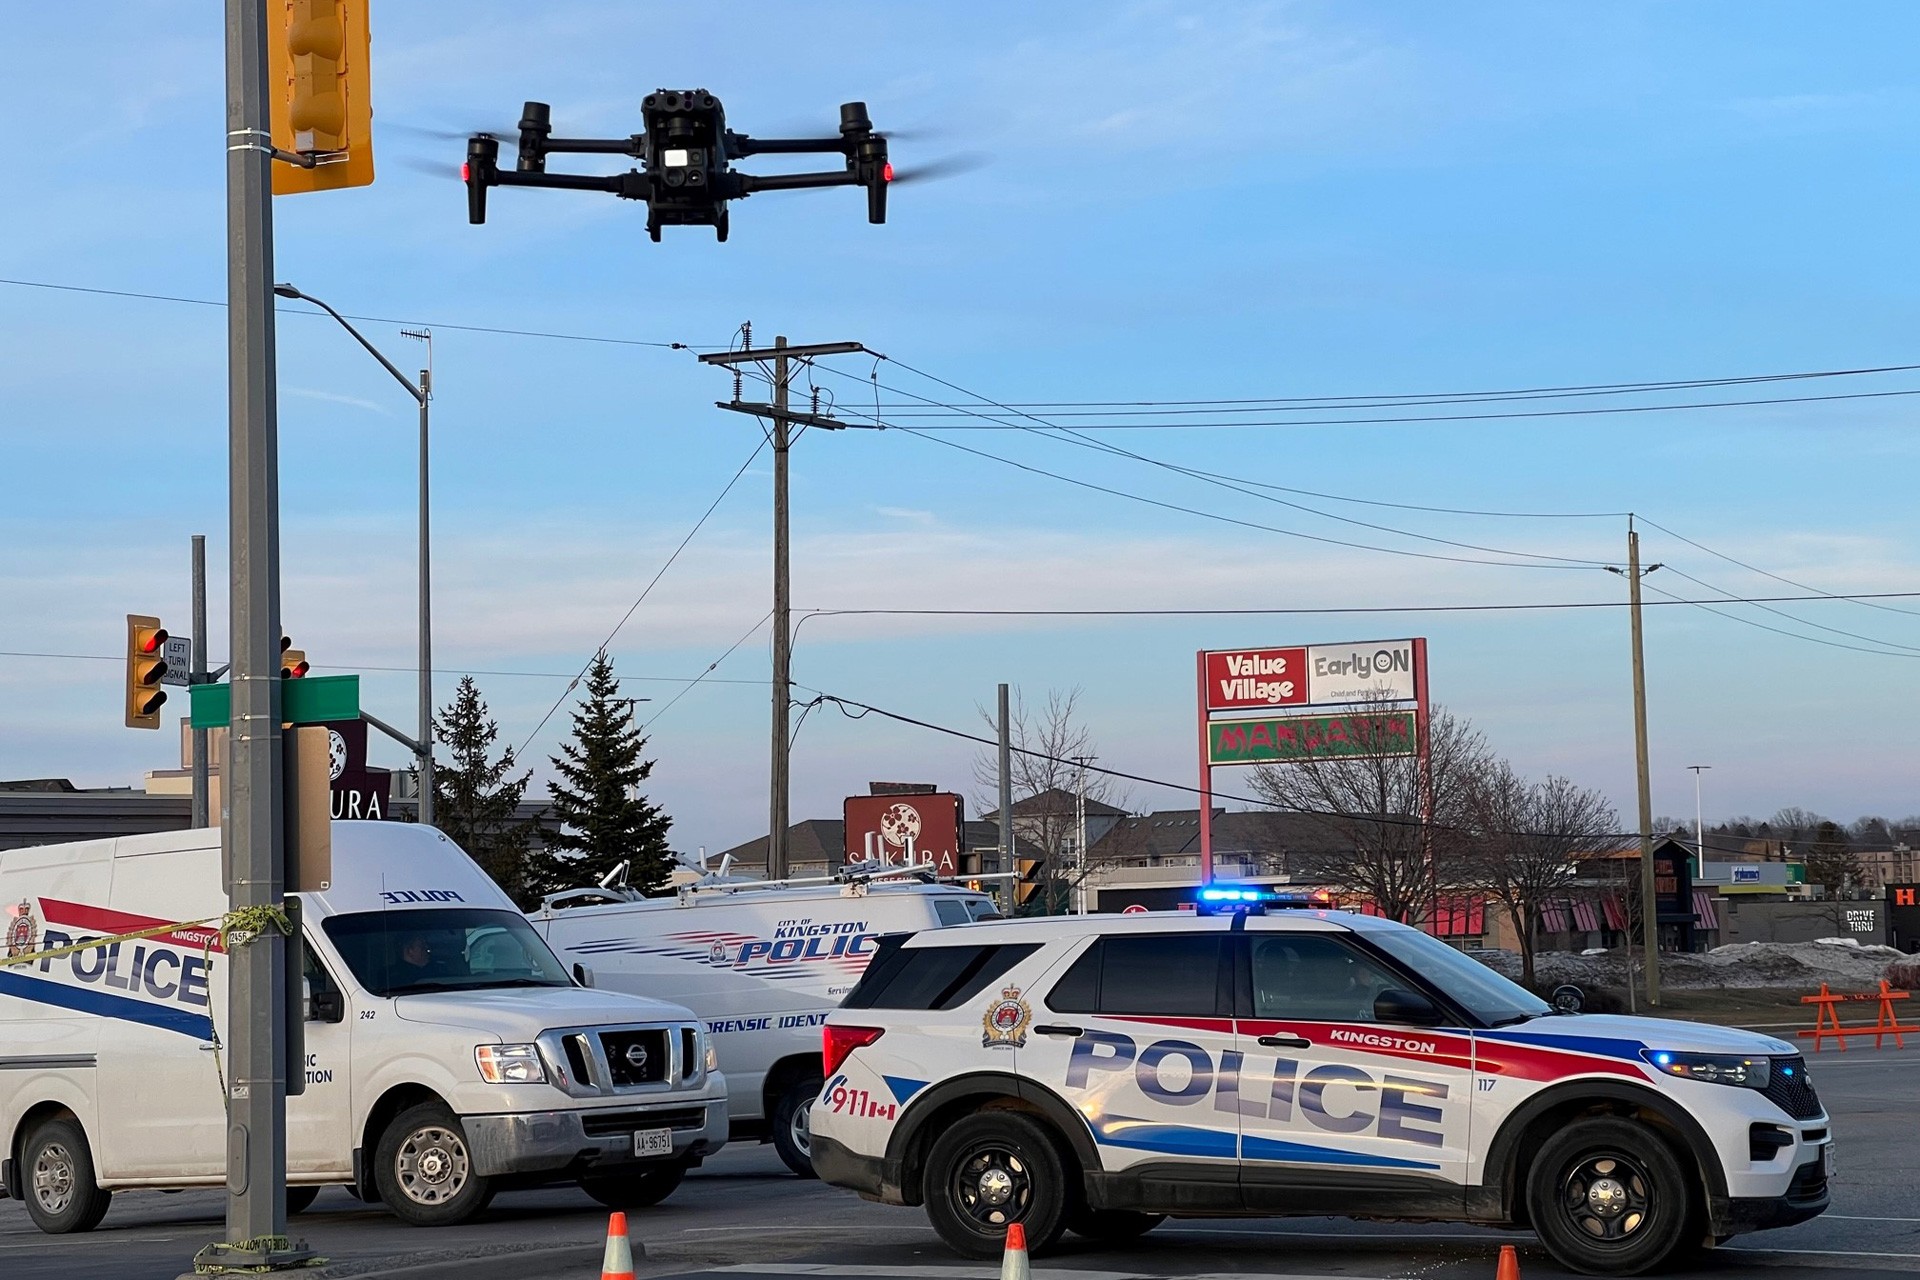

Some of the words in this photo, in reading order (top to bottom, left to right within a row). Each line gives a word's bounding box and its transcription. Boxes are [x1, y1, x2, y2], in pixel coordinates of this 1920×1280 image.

[169, 643, 185, 653] LEFT
[168, 656, 186, 666] TURN
[1226, 654, 1287, 677] Value
[1314, 649, 1409, 680] EarlyON
[1220, 677, 1295, 704] Village
[330, 790, 382, 819] URA
[849, 849, 955, 870] SKRA
[800, 918, 812, 926] OF
[1846, 910, 1875, 921] DRIVE
[774, 921, 869, 939] KINGSTON
[1848, 921, 1874, 932] THRU
[732, 933, 881, 967] POLIC
[40, 929, 214, 1007] POLICE
[360, 1010, 376, 1020] 242
[778, 1013, 829, 1028] IDENT
[1330, 1029, 1436, 1054] KINGSTON
[1065, 1028, 1450, 1148] POLICE
[1477, 1077, 1497, 1091] 117
